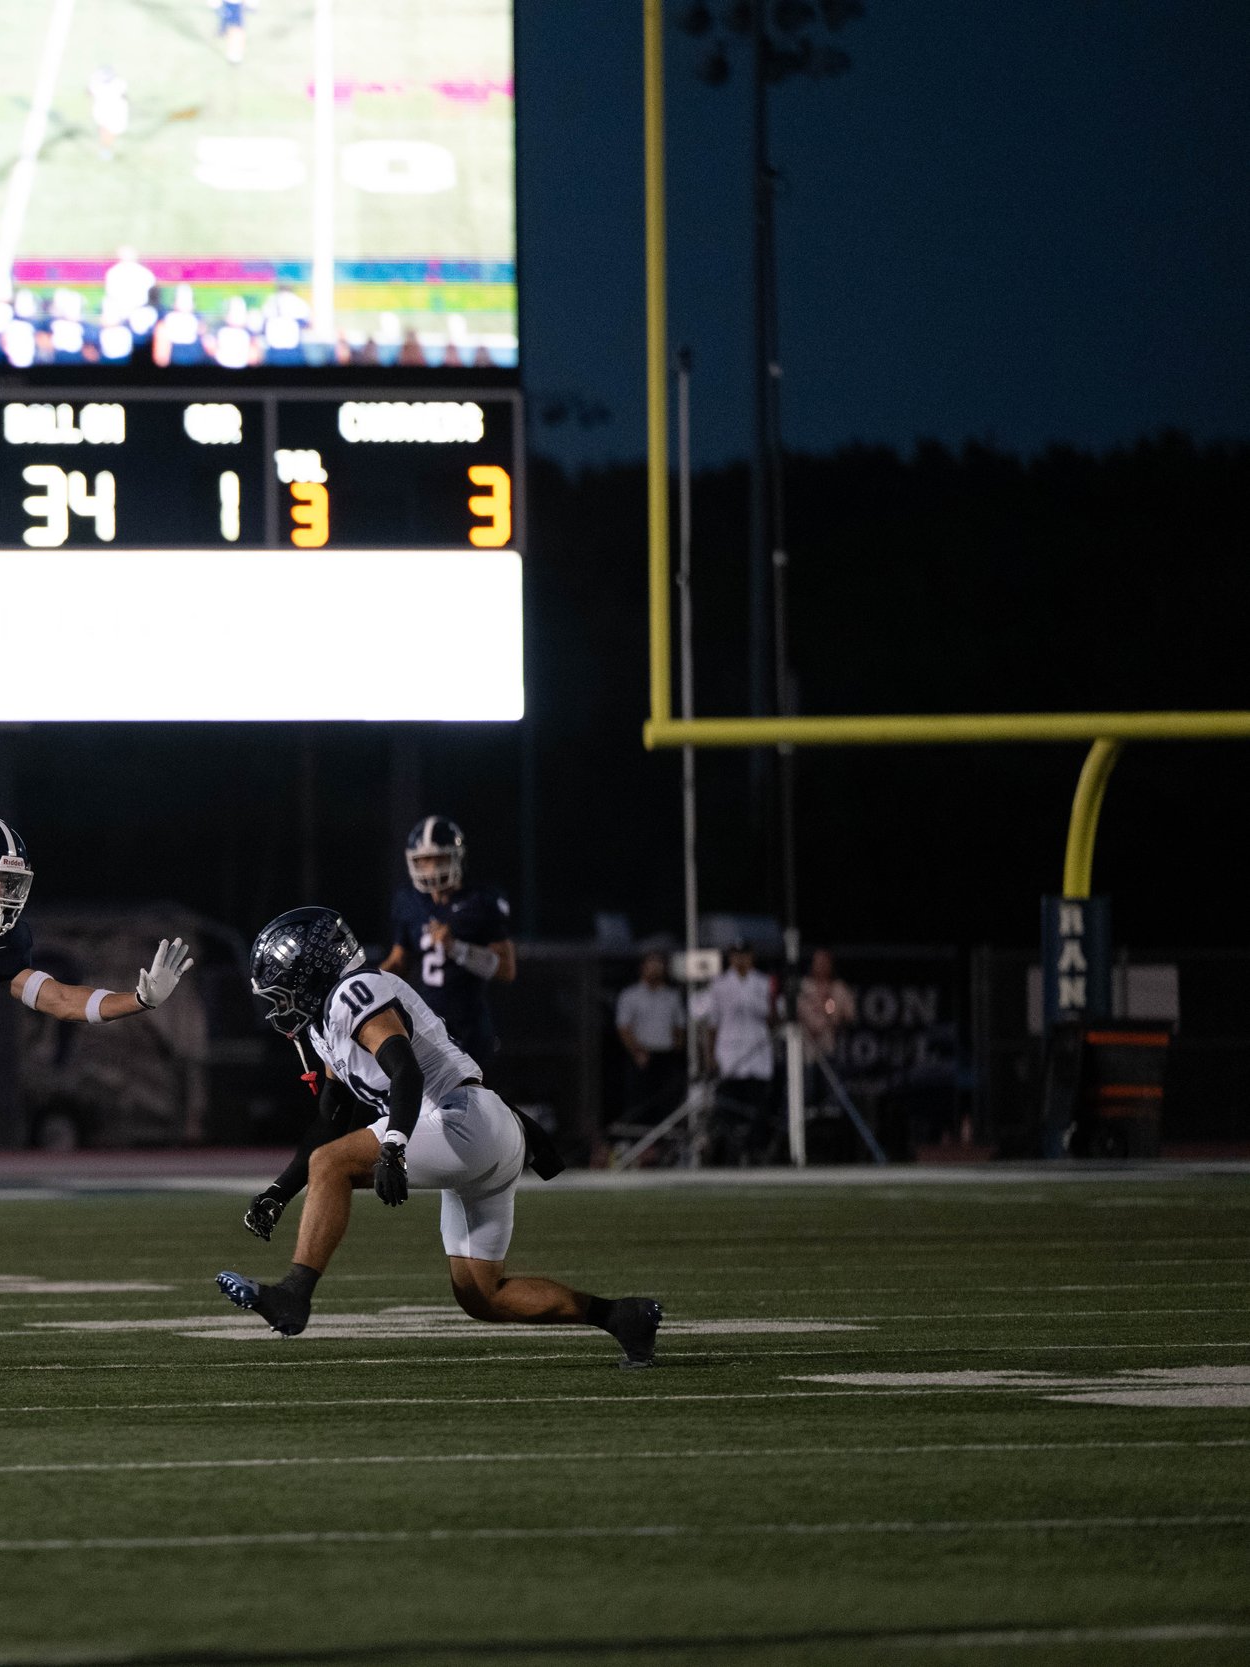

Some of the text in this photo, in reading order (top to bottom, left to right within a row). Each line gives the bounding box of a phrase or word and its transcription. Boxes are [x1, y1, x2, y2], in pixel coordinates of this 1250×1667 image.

[22, 465, 116, 548] 34
[220, 471, 240, 542] 1
[290, 482, 330, 548] 3
[467, 465, 512, 548] 3
[340, 980, 374, 1016] 10
